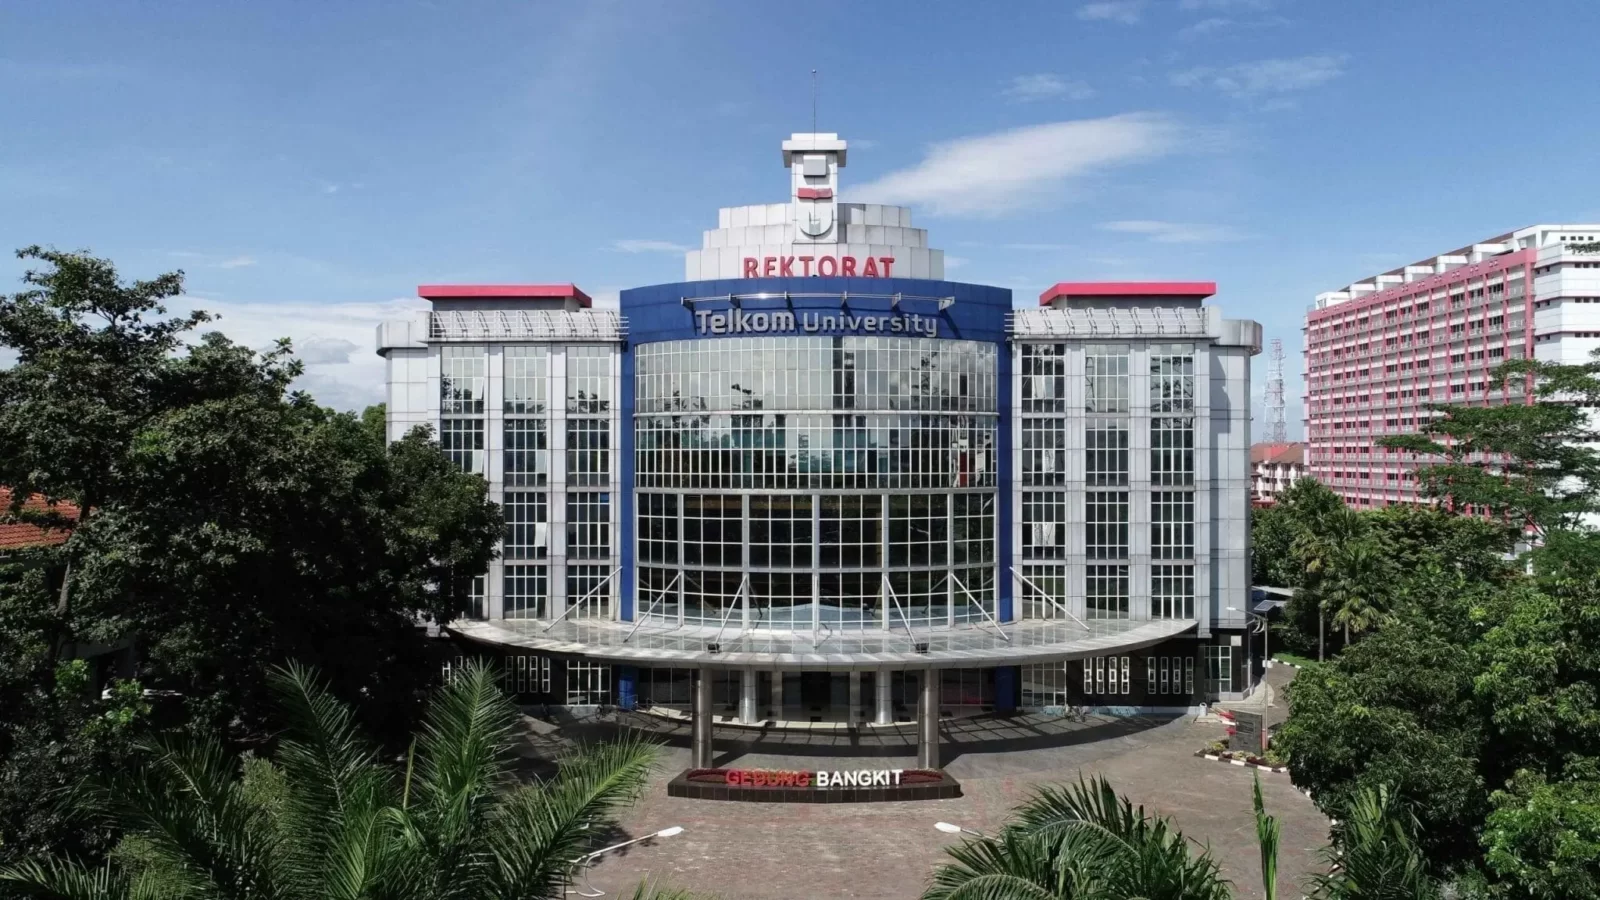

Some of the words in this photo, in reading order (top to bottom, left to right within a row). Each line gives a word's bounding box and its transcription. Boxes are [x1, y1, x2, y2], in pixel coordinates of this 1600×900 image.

[743, 256, 895, 278] REKTORAT
[695, 308, 795, 334] Telkom
[803, 312, 938, 338] University
[725, 769, 811, 787] GEDUNG
[816, 769, 903, 787] BANGKIT
